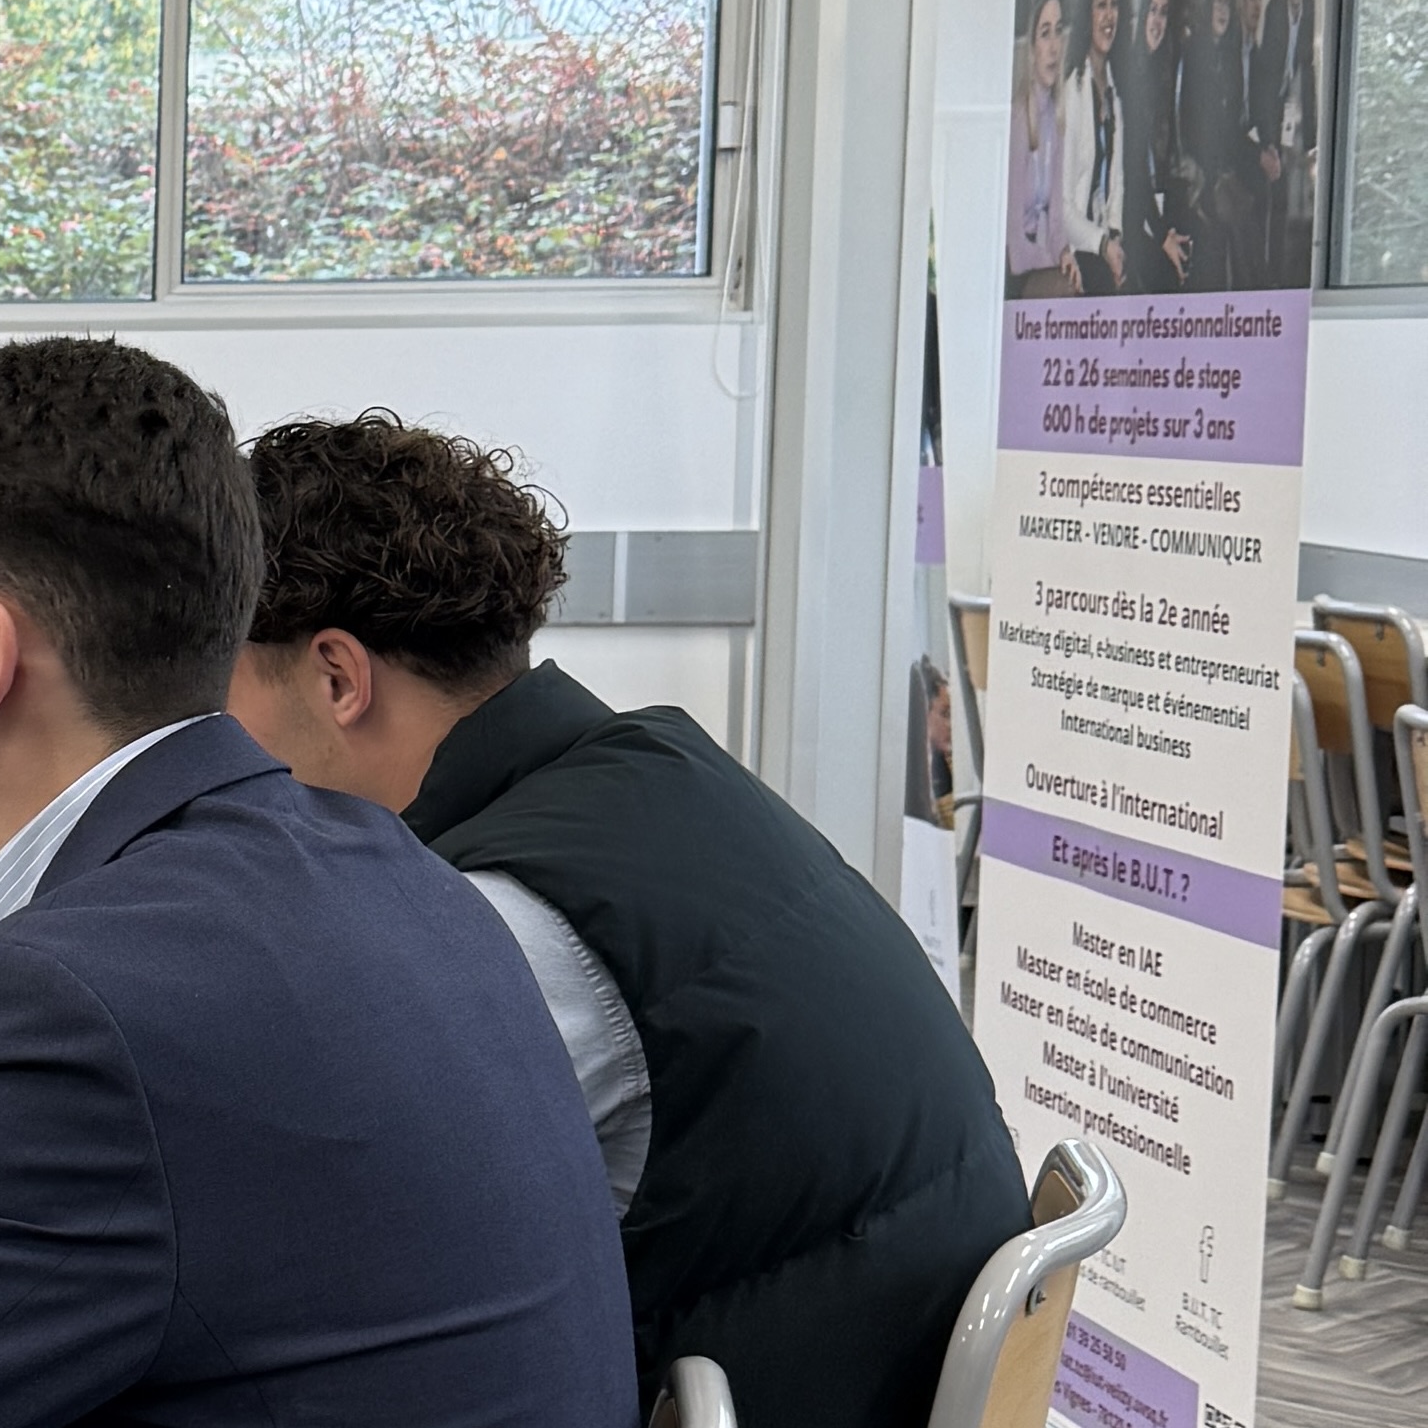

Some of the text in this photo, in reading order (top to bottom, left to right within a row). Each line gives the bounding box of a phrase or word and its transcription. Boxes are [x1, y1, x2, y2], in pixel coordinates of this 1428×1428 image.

[1015, 304, 1282, 347] Une formation professionnalisante
[1043, 357, 1241, 399] 22 à 26 semaines de stage
[1043, 404, 1235, 444] 600 h de projets sur 3 ans
[1039, 471, 1241, 513] 3 compétences essentielles
[1019, 515, 1083, 543] MARKETER
[1094, 522, 1139, 549] VENDRE
[1150, 528, 1262, 565] COMMUNIQUER
[1035, 580, 1230, 635] 3 parcours dès la 2e année
[999, 620, 1280, 691] Marketing digital, e-business et entrepreneuriat
[1031, 665, 1251, 731] Stratégie de marque et événementiel
[1061, 709, 1192, 759] International business
[1026, 763, 1224, 840] Ouverture à l'international
[1052, 835, 1190, 903] Et après le B.U.T. ?
[1072, 921, 1163, 977] Master en IAE
[1017, 945, 1217, 1045] Master en école de commerce
[1000, 981, 1235, 1100] Master en école de communication
[1043, 1041, 1179, 1123] Master à l'université
[1024, 1076, 1192, 1175] Insertion professionnelle
